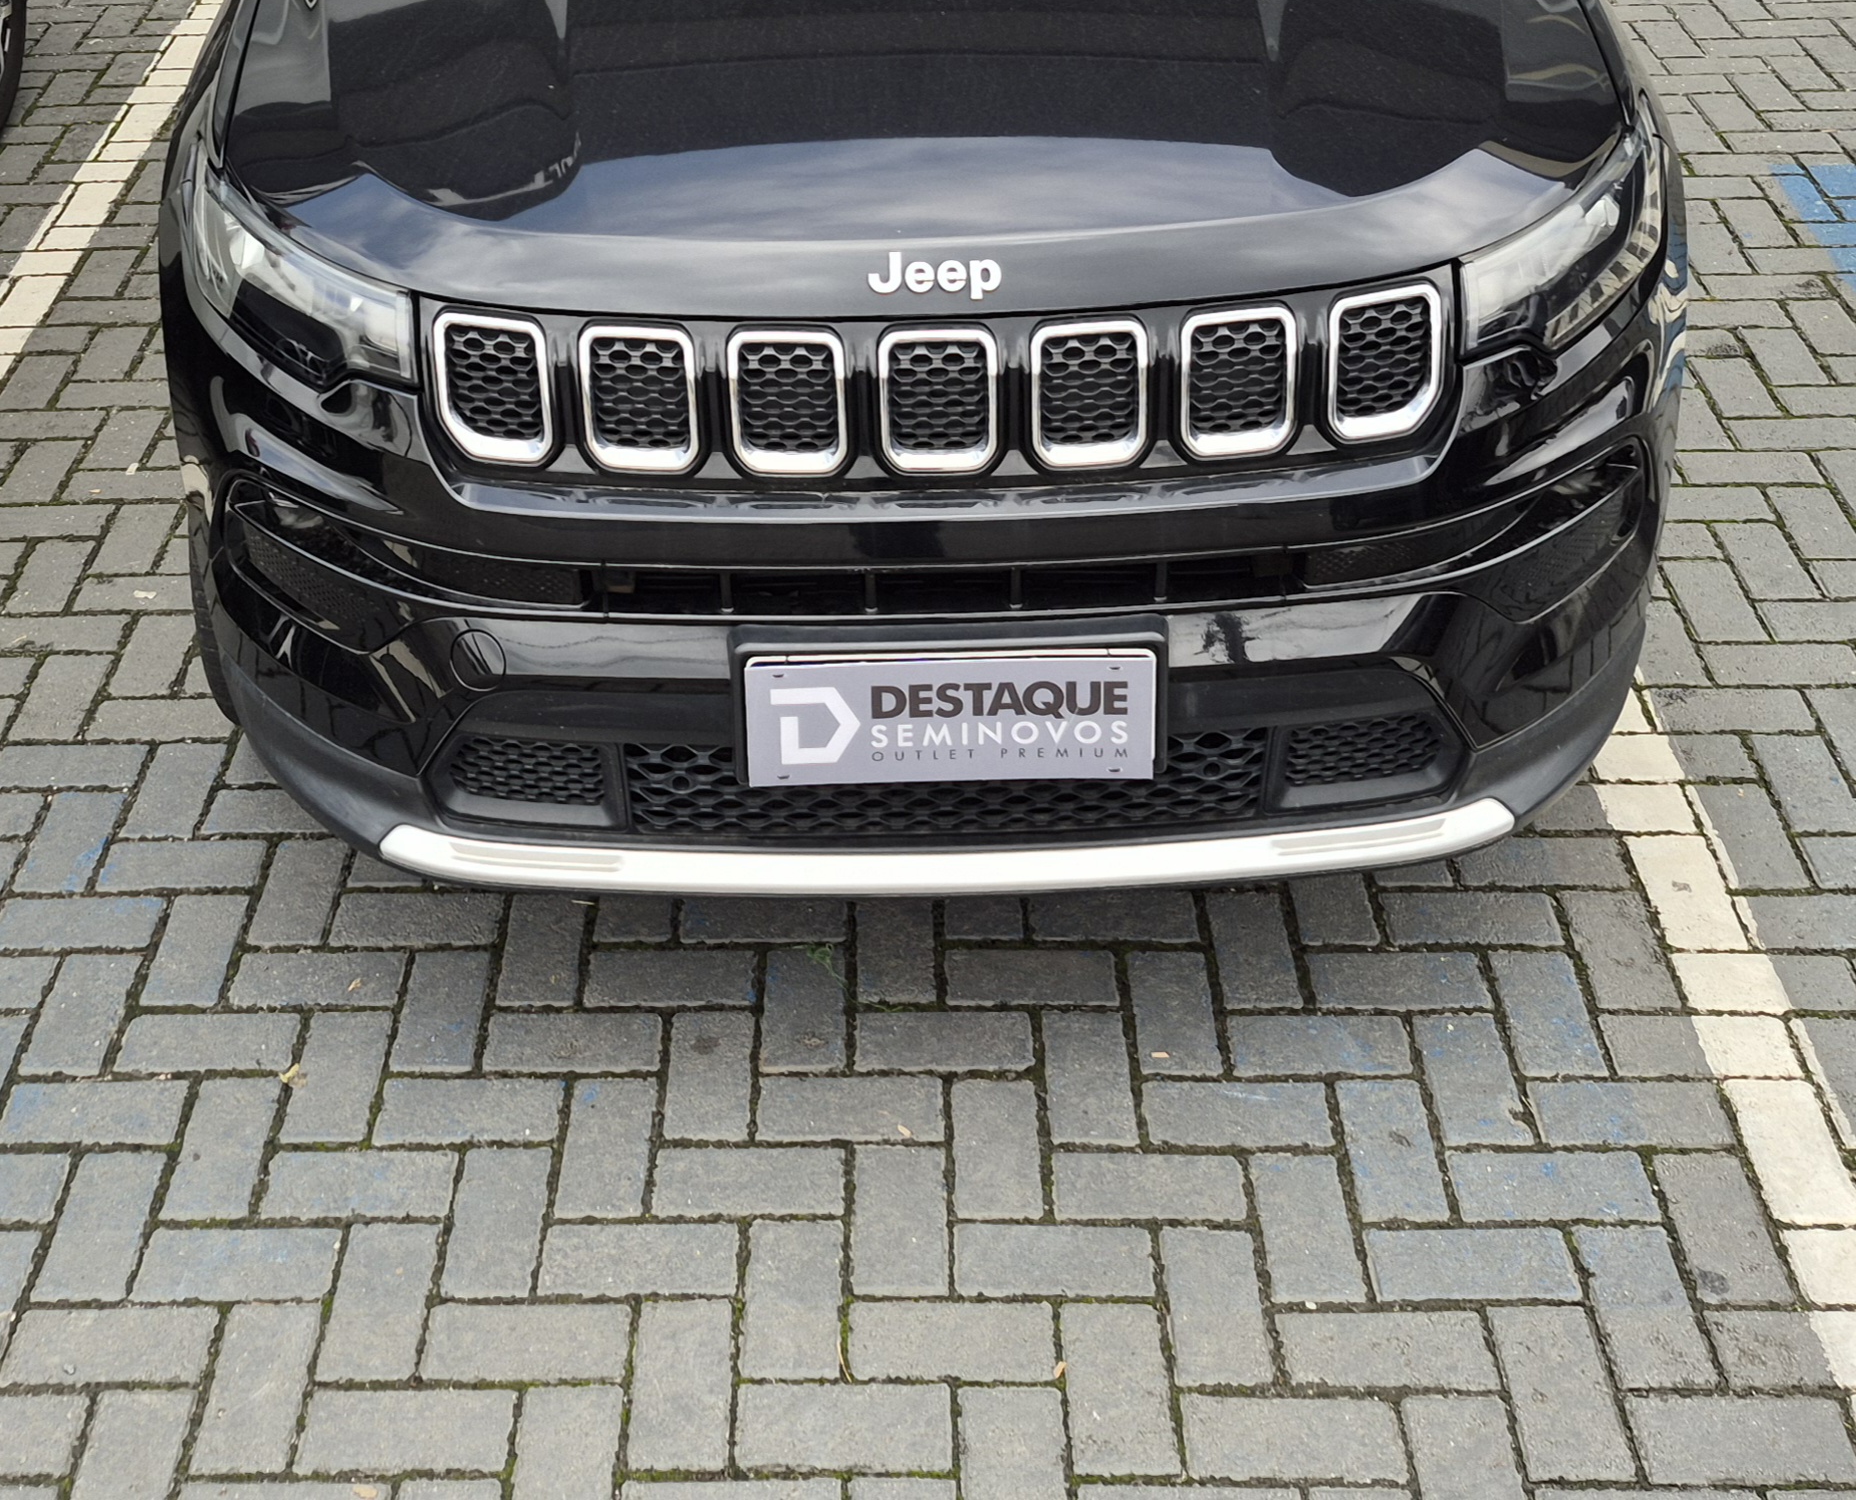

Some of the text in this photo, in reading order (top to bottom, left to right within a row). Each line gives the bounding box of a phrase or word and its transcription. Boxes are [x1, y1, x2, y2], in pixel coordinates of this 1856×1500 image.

[867, 251, 1002, 300] Jeep
[870, 680, 1129, 720] DESTAQUE
[870, 720, 1129, 749] SEMINOVOS
[871, 747, 1129, 762] OUTLET PREMIUM
